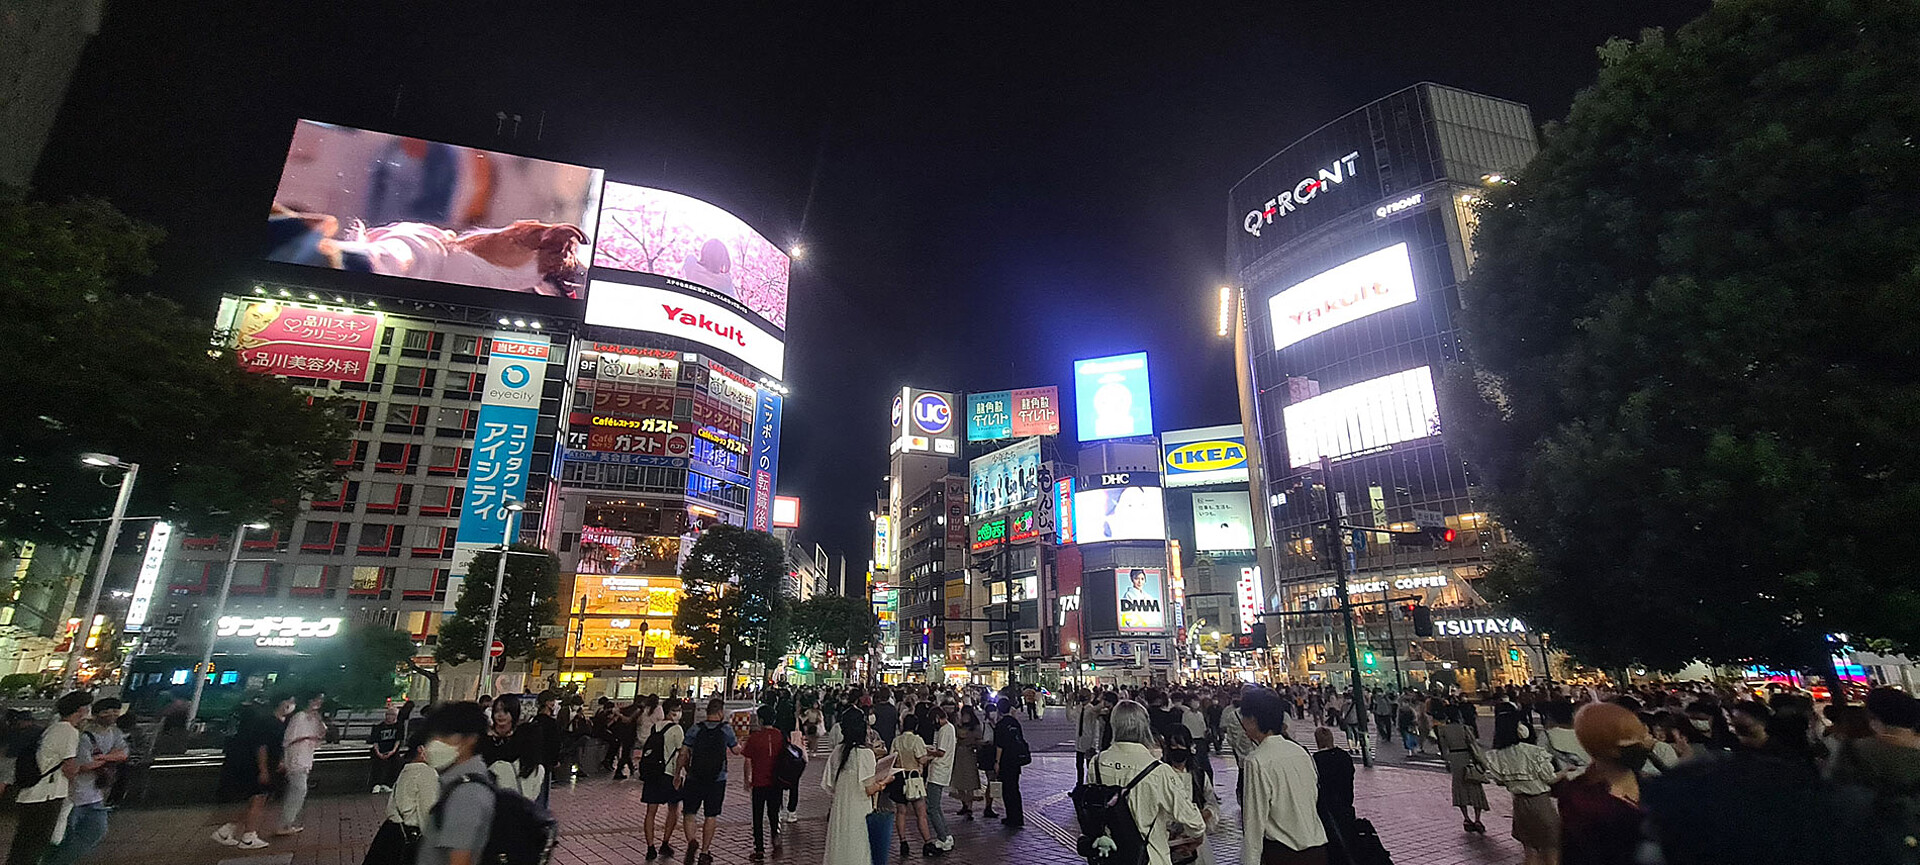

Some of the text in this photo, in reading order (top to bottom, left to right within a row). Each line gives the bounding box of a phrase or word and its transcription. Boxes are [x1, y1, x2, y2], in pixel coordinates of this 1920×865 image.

[302, 315, 370, 332] 品川スキン
[661, 303, 746, 347] Yakult
[301, 327, 361, 343] クリニック
[497, 342, 543, 355] 当ビル5F
[251, 352, 360, 375] 品川美容外科
[580, 361, 596, 371] 9F
[490, 389, 535, 402] eyecity
[641, 418, 679, 434] ガスト
[693, 403, 740, 433] コンタクト
[569, 432, 588, 443] 7F
[614, 434, 661, 452] ガスト
[726, 438, 748, 455] ガスト
[1173, 446, 1244, 465] IKEA
[471, 422, 509, 521] アイシティ
[1101, 473, 1130, 486] DHC
[1037, 464, 1054, 531] もんじゃ
[1395, 575, 1448, 590] COFFEE
[1120, 599, 1160, 613] DMM
[217, 616, 342, 637] サンドラッグ
[1435, 617, 1526, 635] TSUTAYA
[1094, 643, 1161, 656] 大堂店
